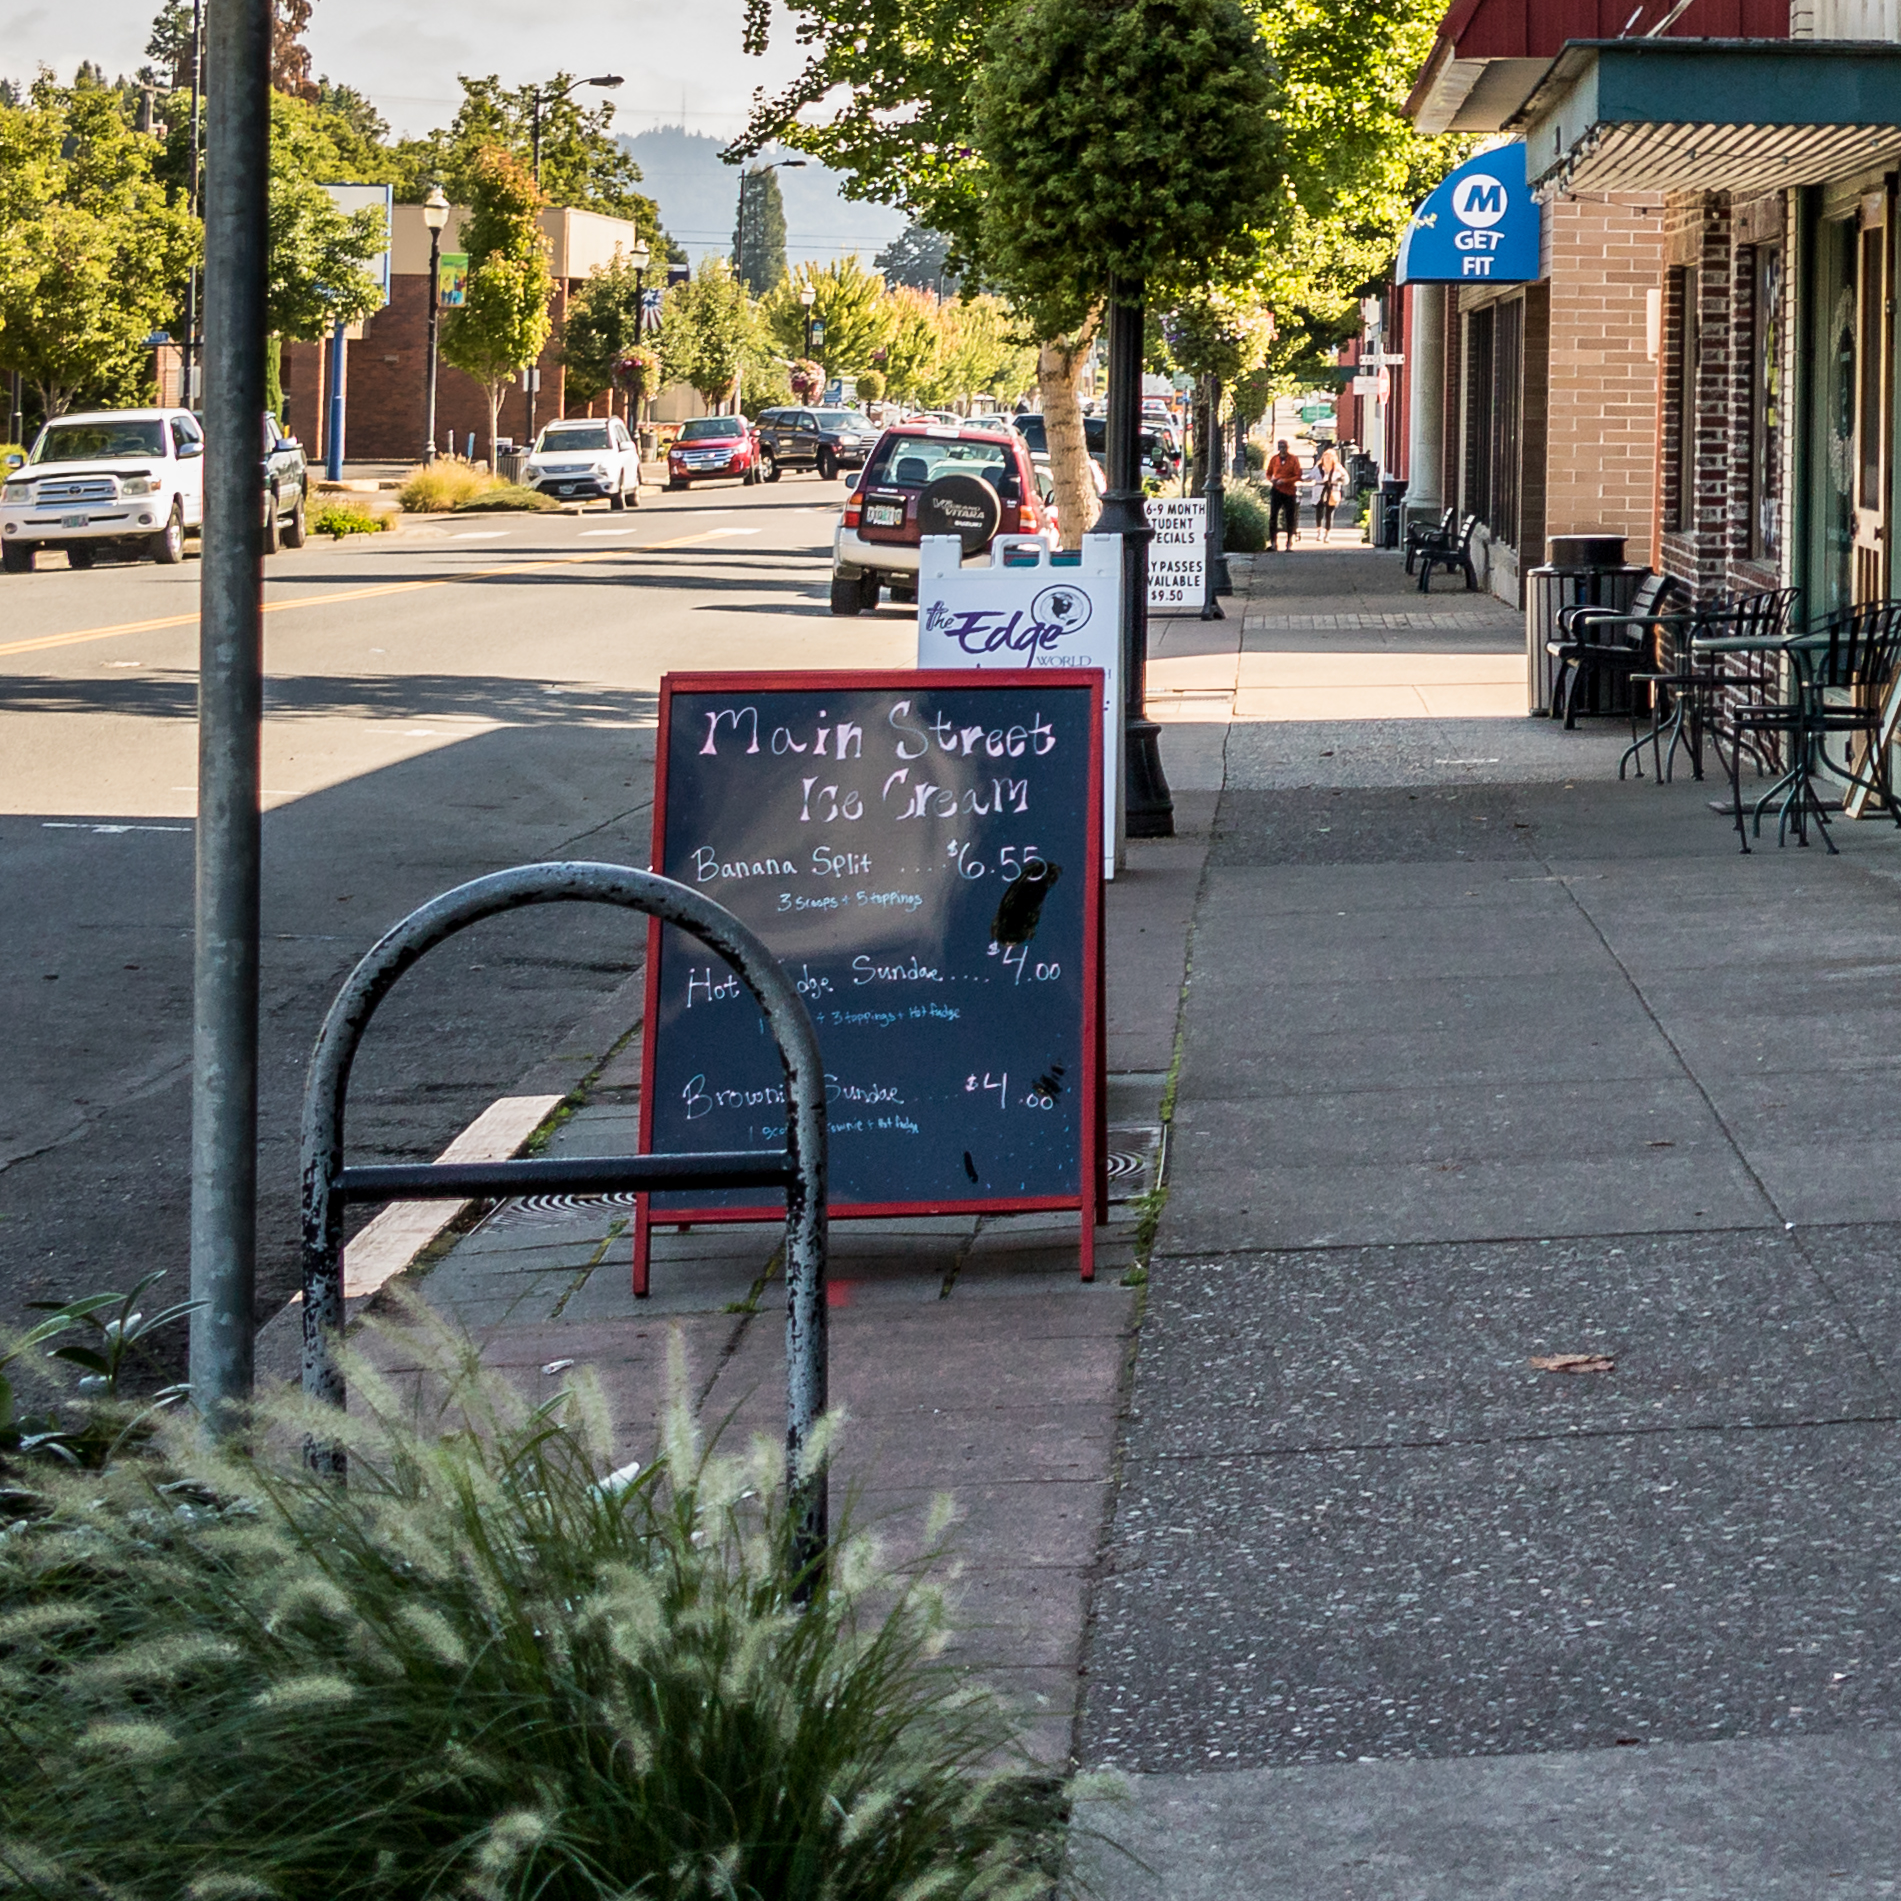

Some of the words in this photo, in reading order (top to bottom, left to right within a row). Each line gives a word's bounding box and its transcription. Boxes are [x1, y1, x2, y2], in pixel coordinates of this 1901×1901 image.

[1454, 231, 1505, 252] GET
[1462, 256, 1493, 276] FIT
[944, 508, 985, 520] VITARA
[1146, 503, 1164, 516] 6-9
[1167, 503, 1206, 515] MONTH
[1151, 518, 1194, 529] TUDENT
[1156, 532, 1195, 544] ECIALS
[1160, 561, 1203, 573] PASSES
[1148, 575, 1201, 587] VAILABLE
[1151, 590, 1184, 602] $9.50
[925, 600, 955, 632] the
[944, 609, 1064, 669] Edge
[1036, 655, 1092, 667] WORLD
[699, 706, 862, 760] Main
[889, 700, 1056, 760] Street
[800, 775, 863, 821] Ice
[882, 768, 1029, 821] Cream
[691, 846, 797, 882] Banana
[812, 845, 872, 878] Split
[947, 840, 1049, 882] $6.55
[777, 892, 792, 912] 3
[856, 891, 867, 906] 5
[685, 967, 740, 1008] Hot
[796, 964, 834, 999] dge
[852, 955, 943, 985] Sundae
[986, 941, 1061, 985] $4.00
[831, 1011, 843, 1025] 3
[682, 1073, 786, 1119] Browni
